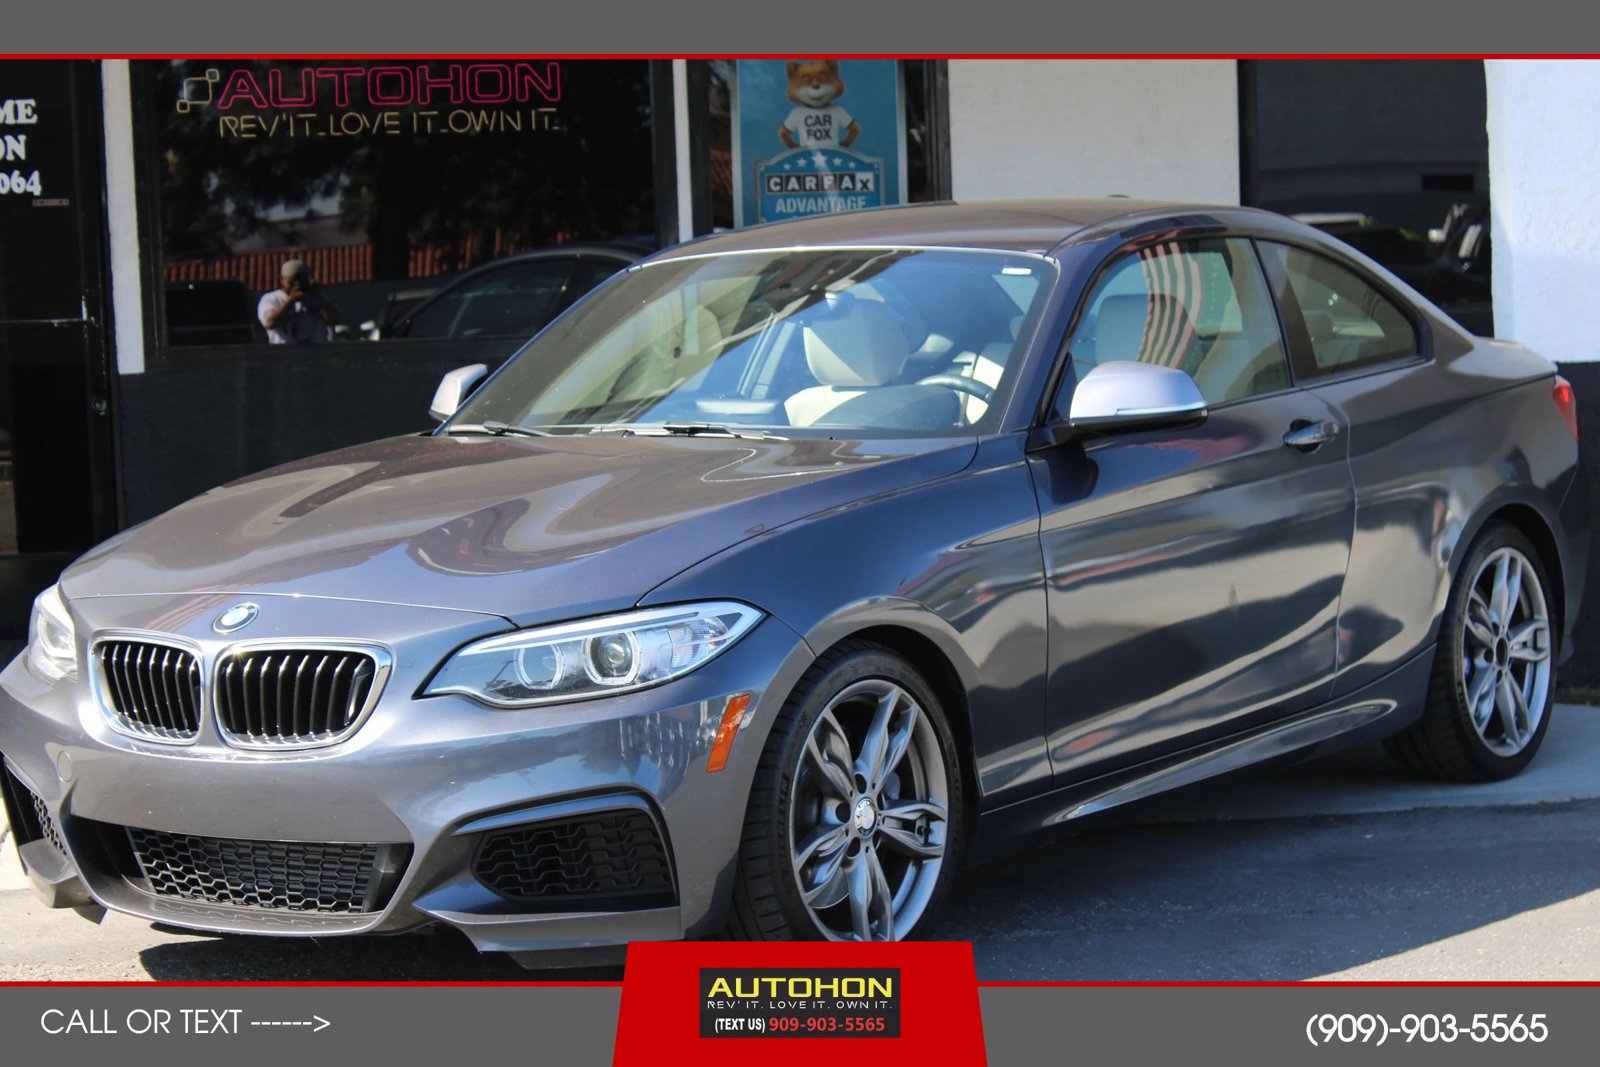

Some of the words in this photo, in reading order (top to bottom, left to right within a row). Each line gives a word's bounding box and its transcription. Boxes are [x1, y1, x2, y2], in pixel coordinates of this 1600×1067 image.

[217, 62, 561, 110] AUTOHON
[329, 111, 401, 136] LOVE
[449, 109, 522, 133] OWN
[804, 114, 833, 128] CAR
[806, 128, 833, 141] FOX
[767, 173, 873, 192] CARFAX
[775, 196, 868, 214] ADVANTAGE
